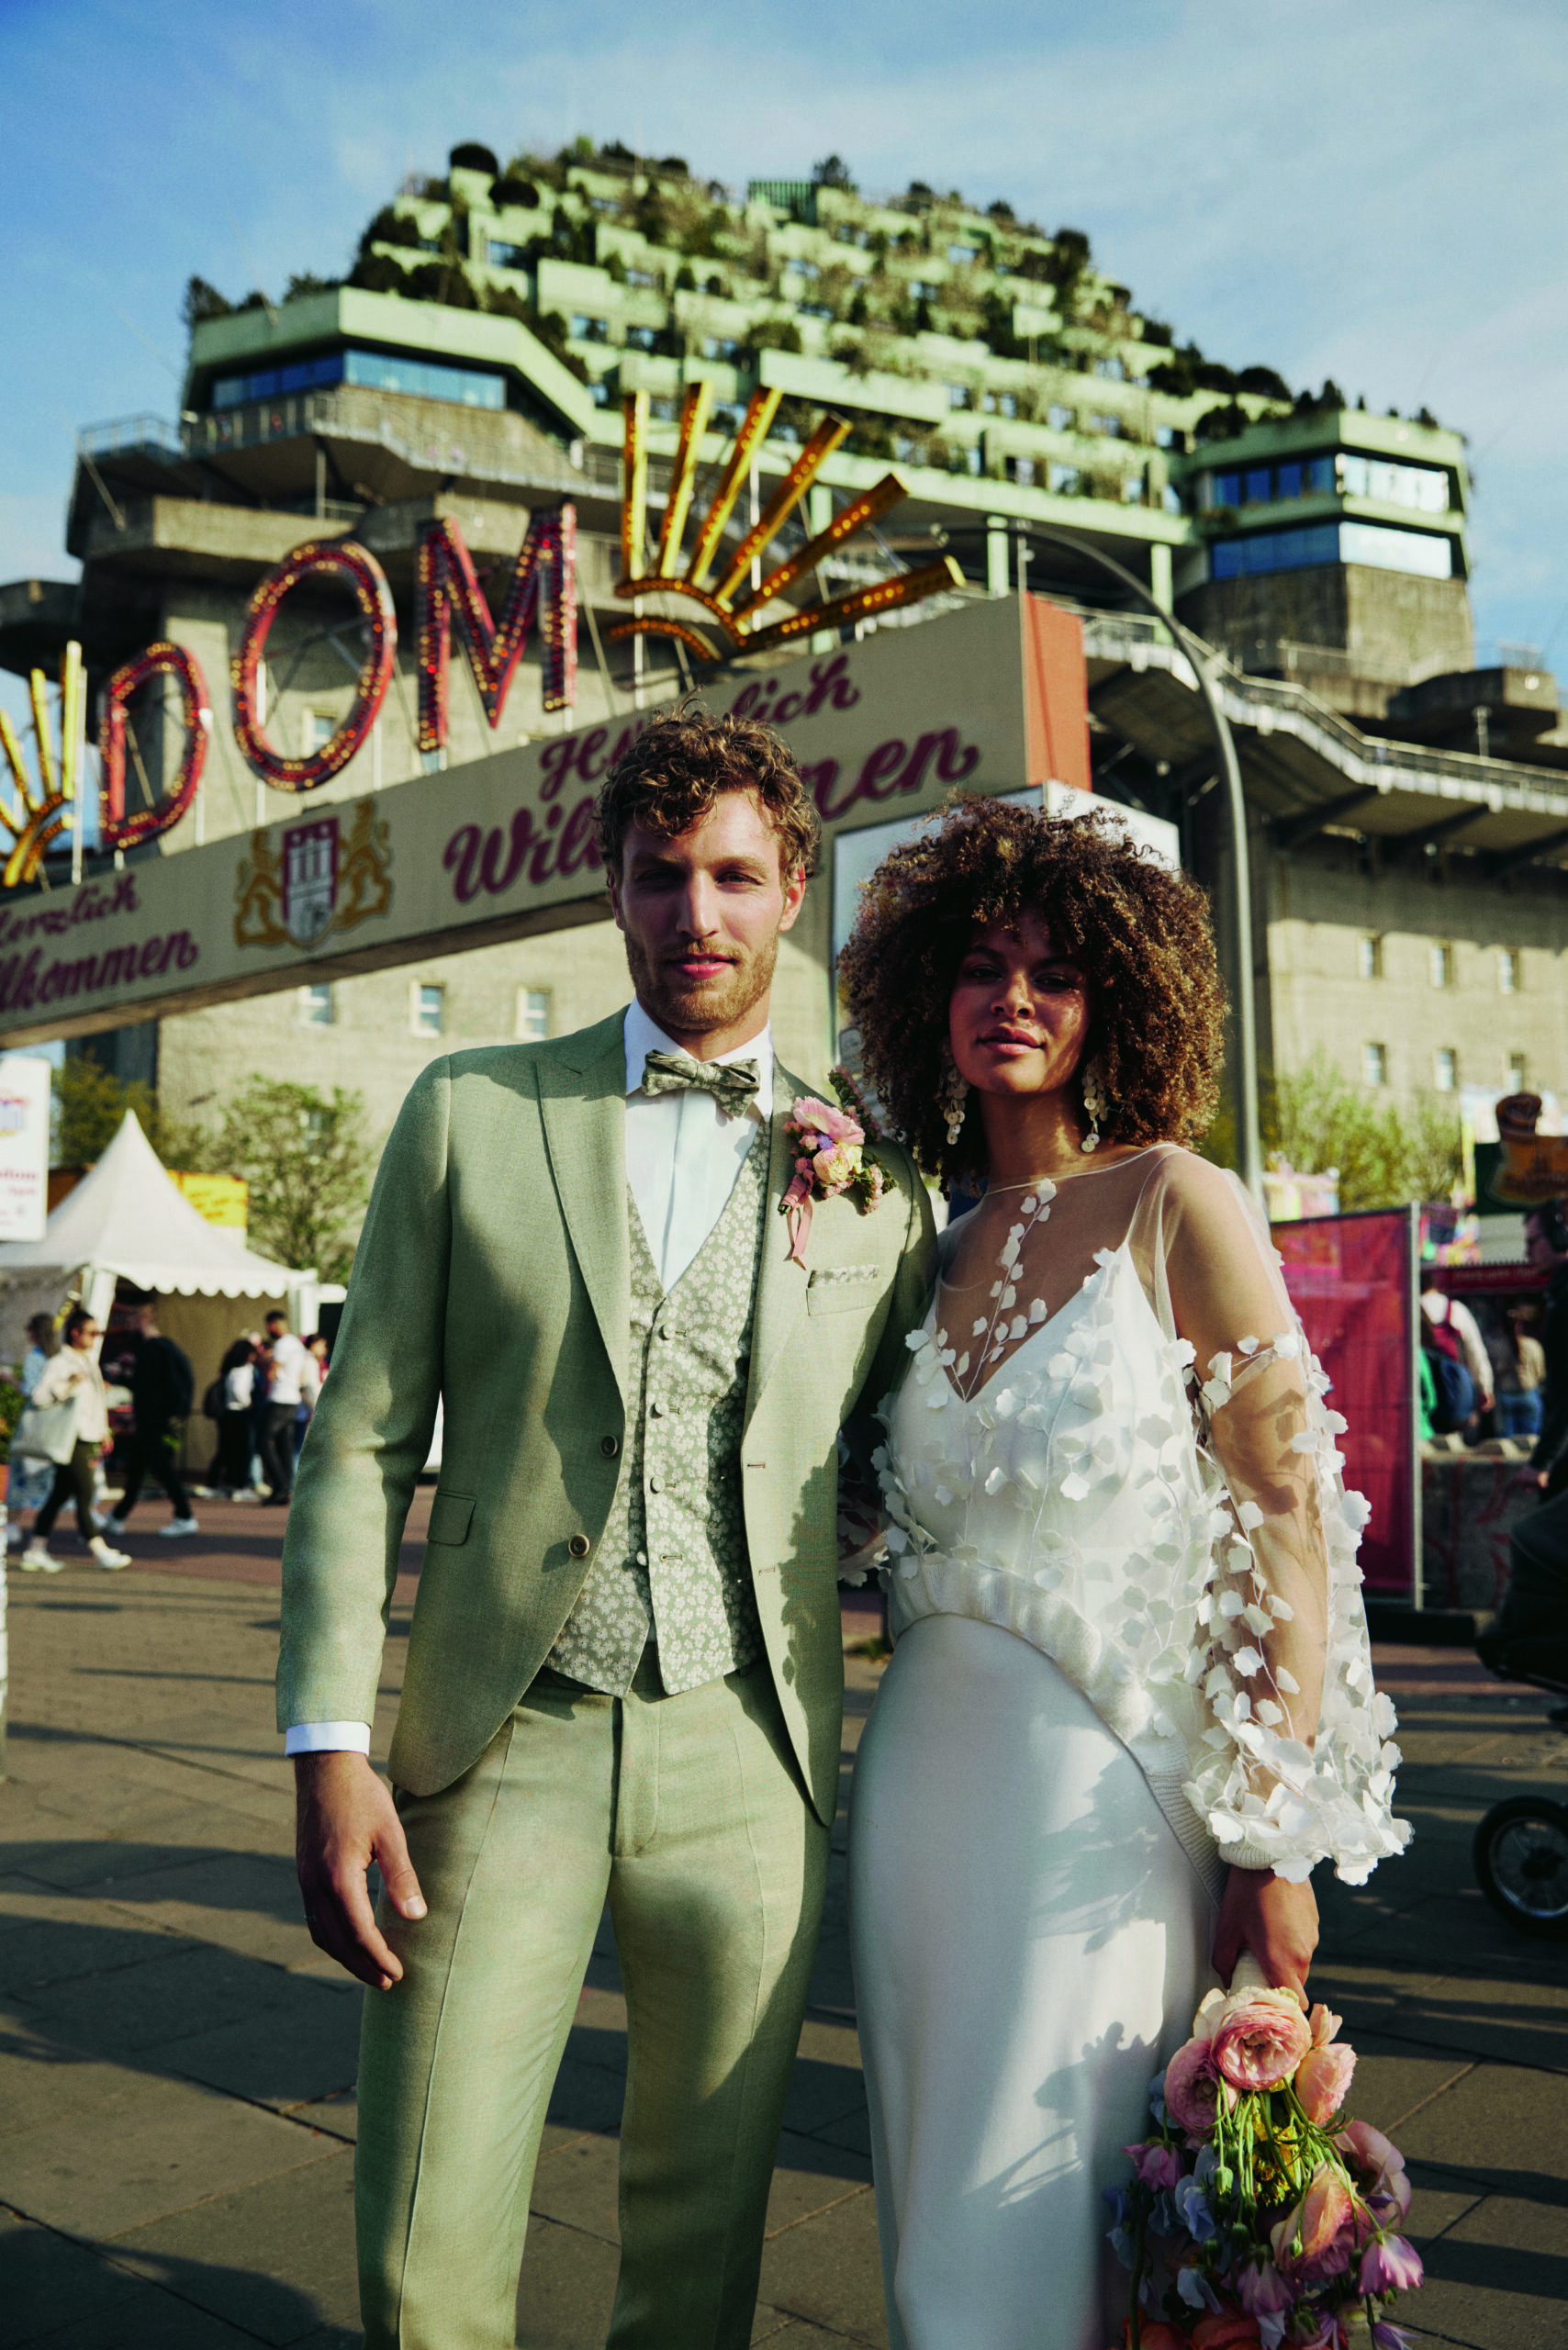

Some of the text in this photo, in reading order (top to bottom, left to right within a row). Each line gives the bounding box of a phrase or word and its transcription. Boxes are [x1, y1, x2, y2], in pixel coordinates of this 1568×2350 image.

[99, 503, 577, 853] DOM
[539, 654, 860, 801] Helich
[0, 929, 198, 1009] lkommen
